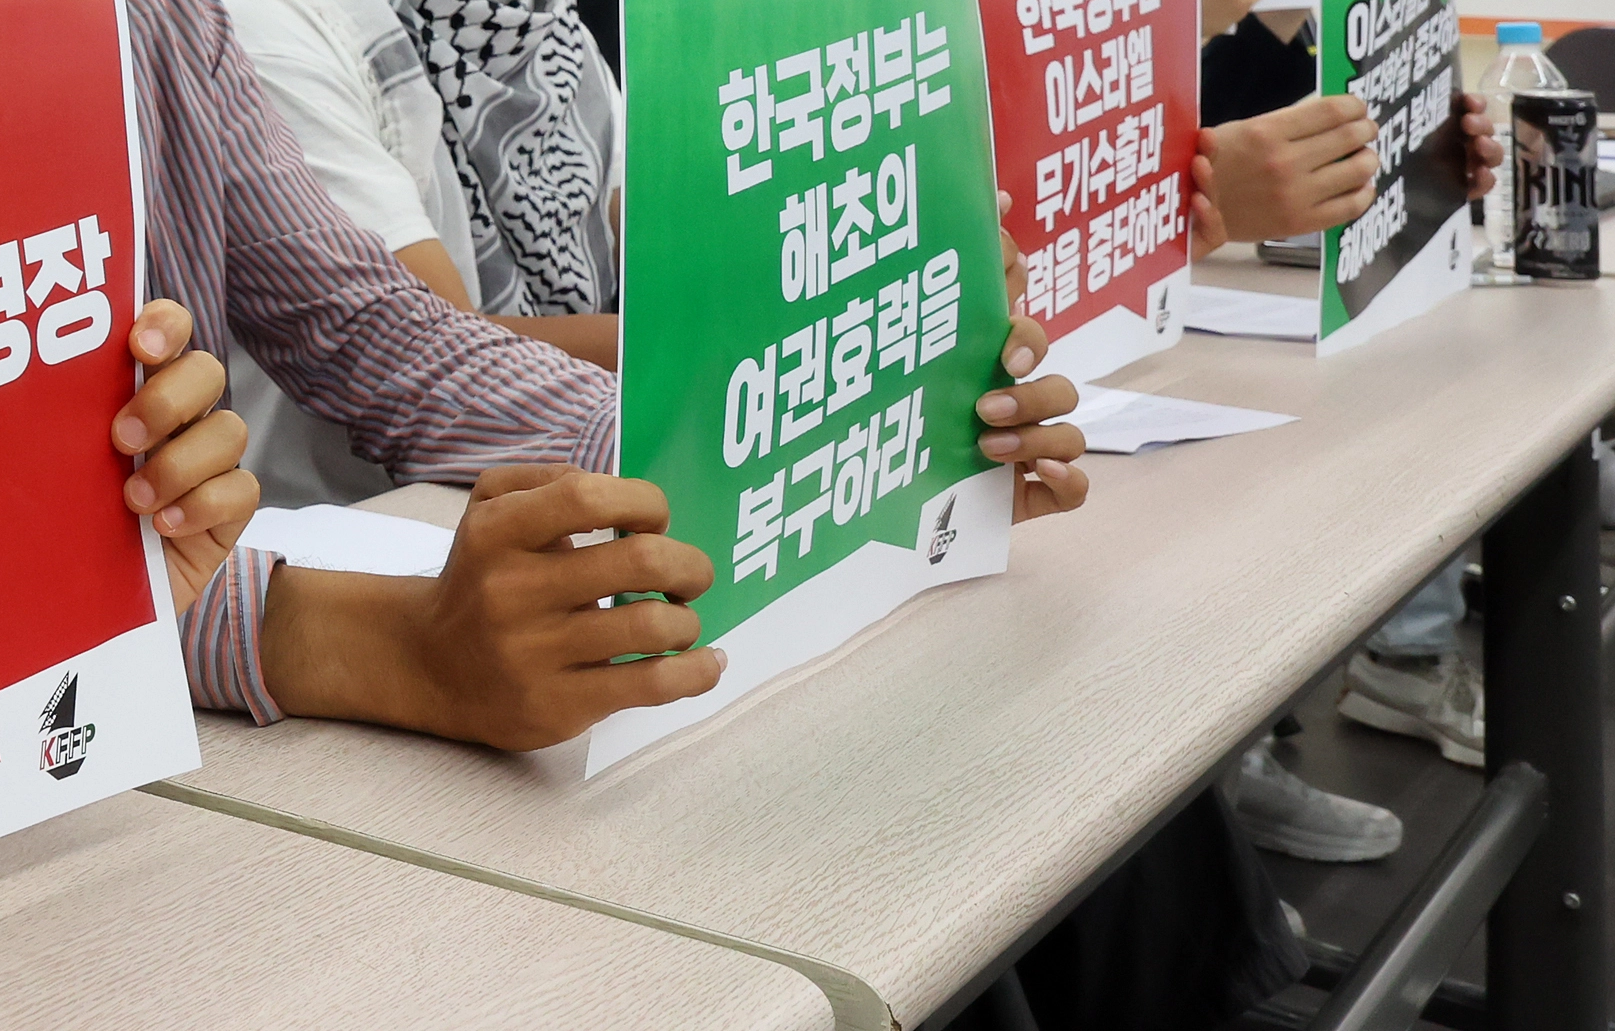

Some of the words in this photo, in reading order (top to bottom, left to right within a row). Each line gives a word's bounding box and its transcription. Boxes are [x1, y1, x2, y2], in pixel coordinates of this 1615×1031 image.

[719, 11, 952, 196] 한국정부는
[1045, 25, 1154, 135] 이스라엘
[1409, 65, 1453, 152] 봉쇄를
[779, 145, 918, 302] 해초의
[1035, 103, 1164, 233] 무기수출과
[1337, 176, 1408, 284] 해제하라.
[1521, 157, 1598, 212] KIN
[1016, 227, 1080, 321] 력을
[1087, 171, 1185, 293] 중단하라.
[721, 248, 961, 468] 여권효력을
[732, 386, 930, 582] 복구하라.
[40, 723, 96, 770] KFFP
